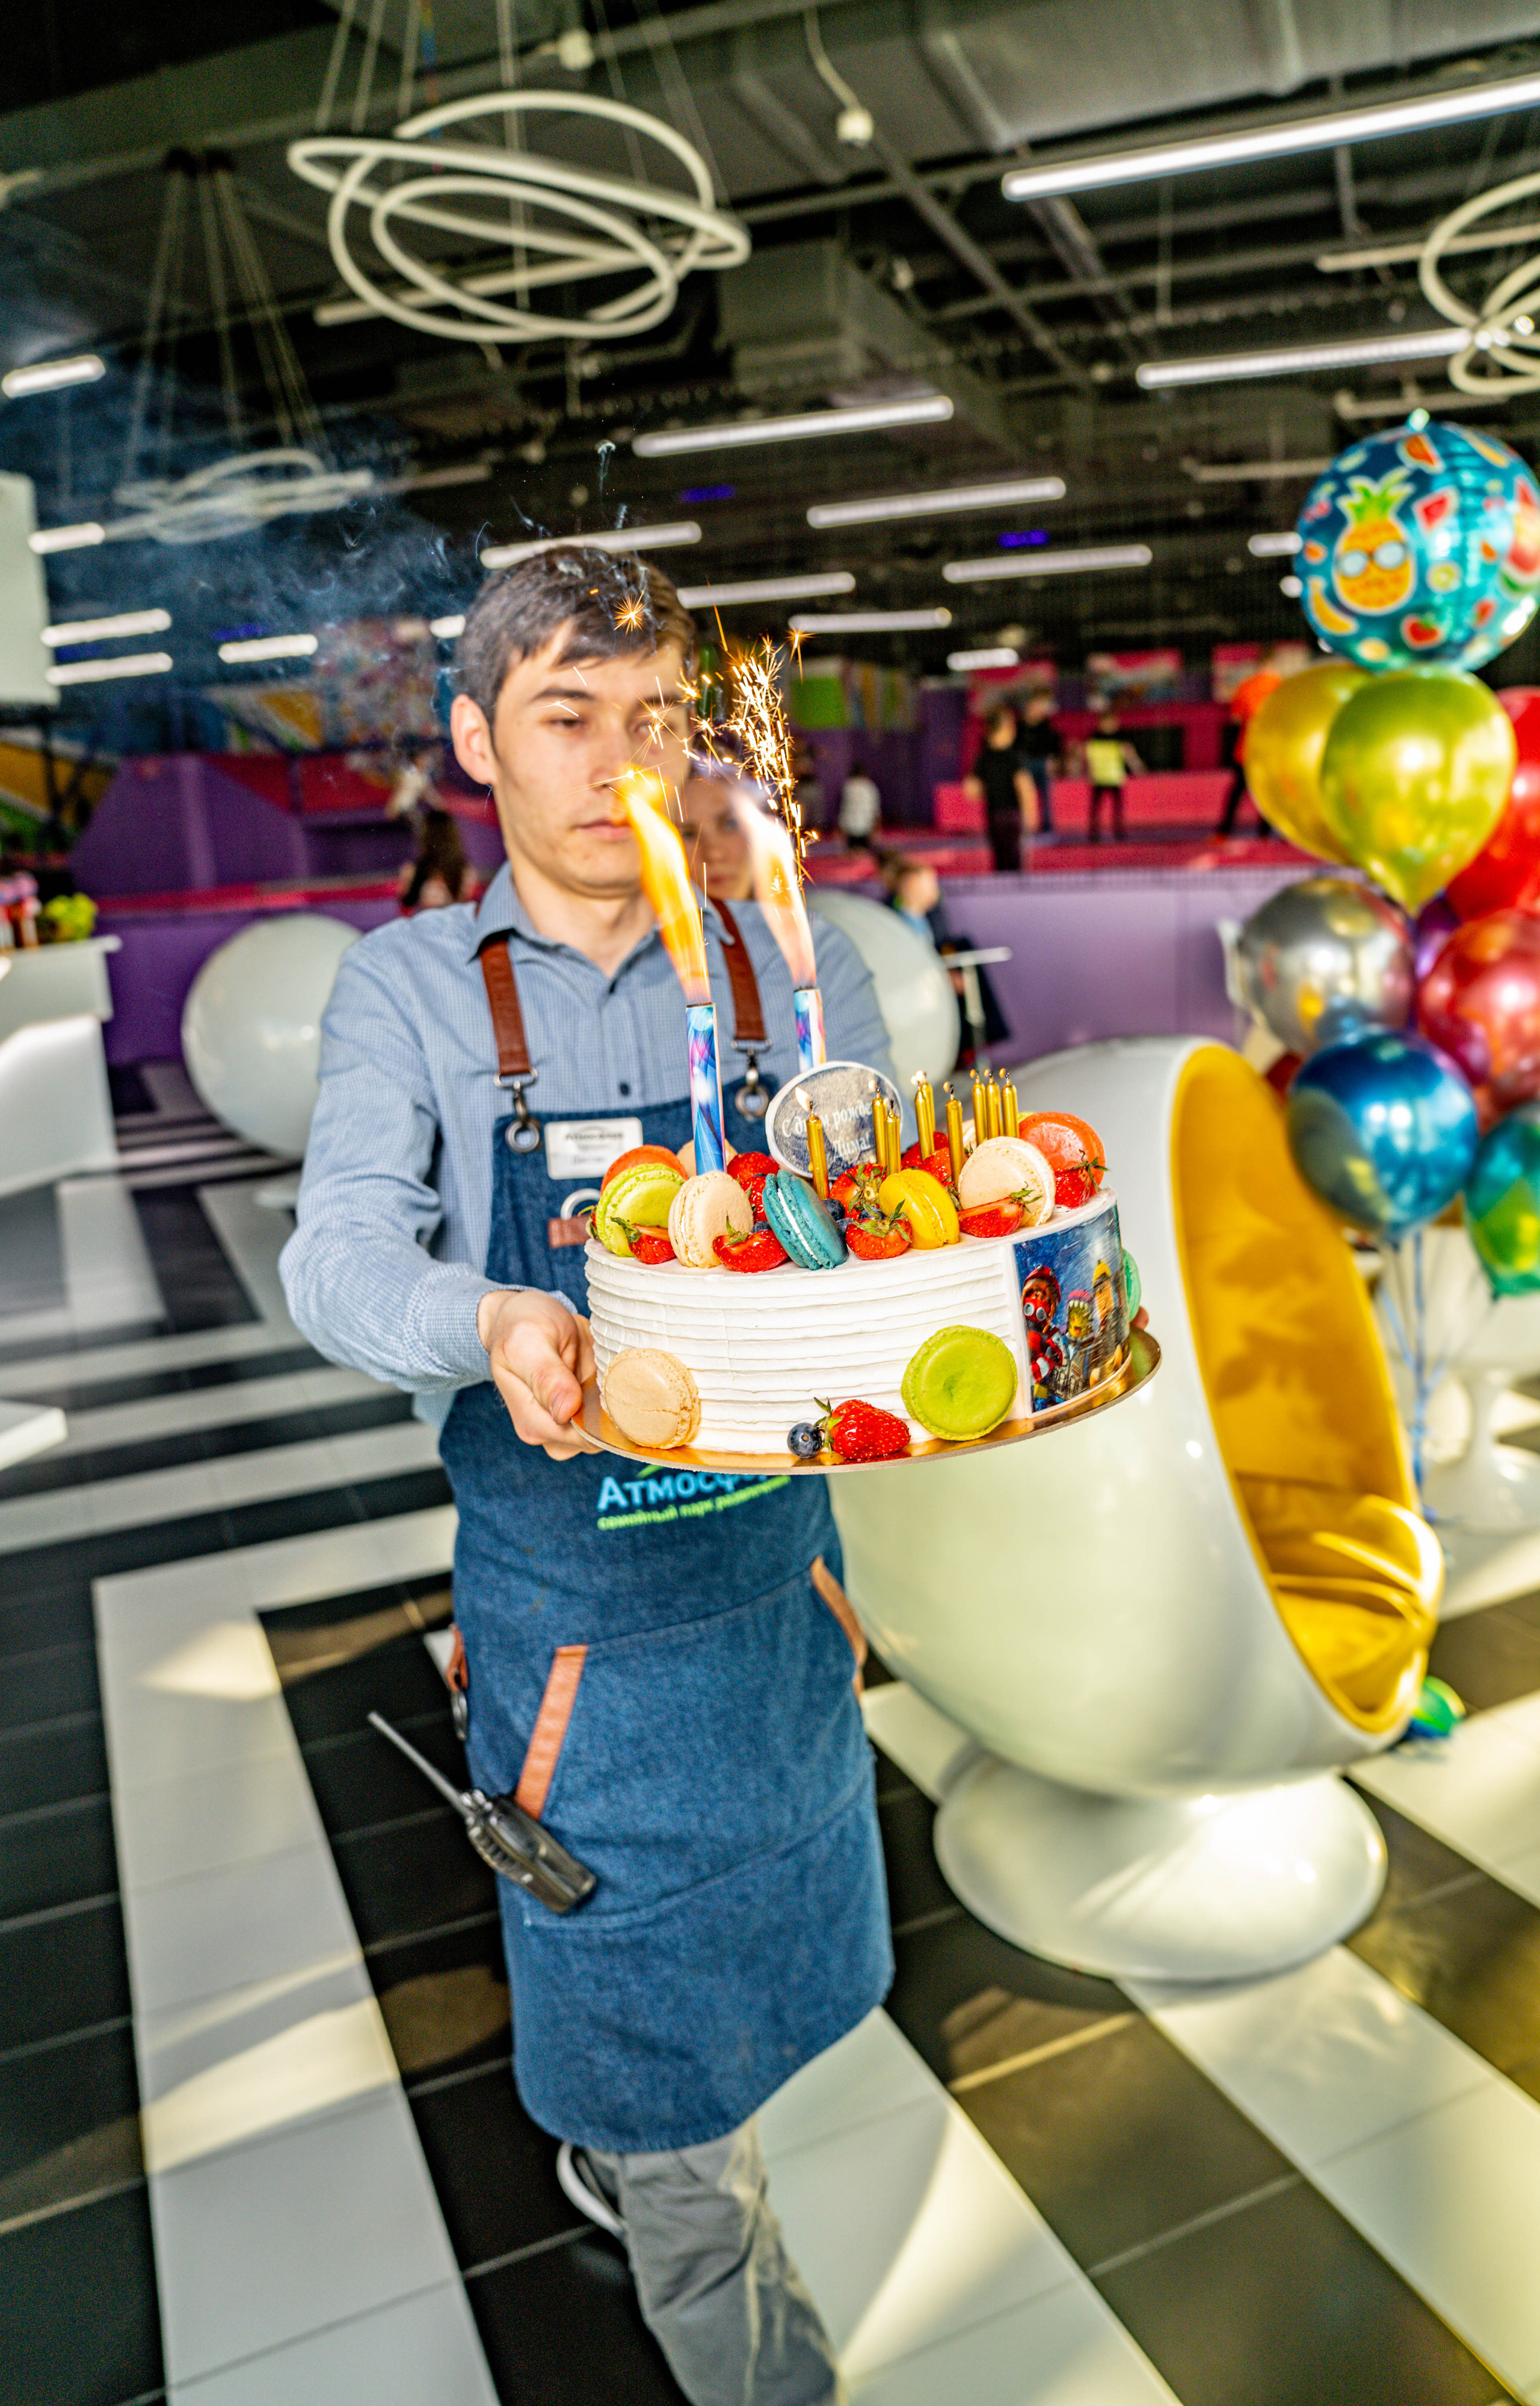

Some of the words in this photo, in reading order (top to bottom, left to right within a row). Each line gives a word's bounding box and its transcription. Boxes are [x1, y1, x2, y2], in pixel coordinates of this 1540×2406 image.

[794, 1114, 830, 1135] дм
[832, 1099, 872, 1131] рожде
[833, 1132, 871, 1162] Дима!
